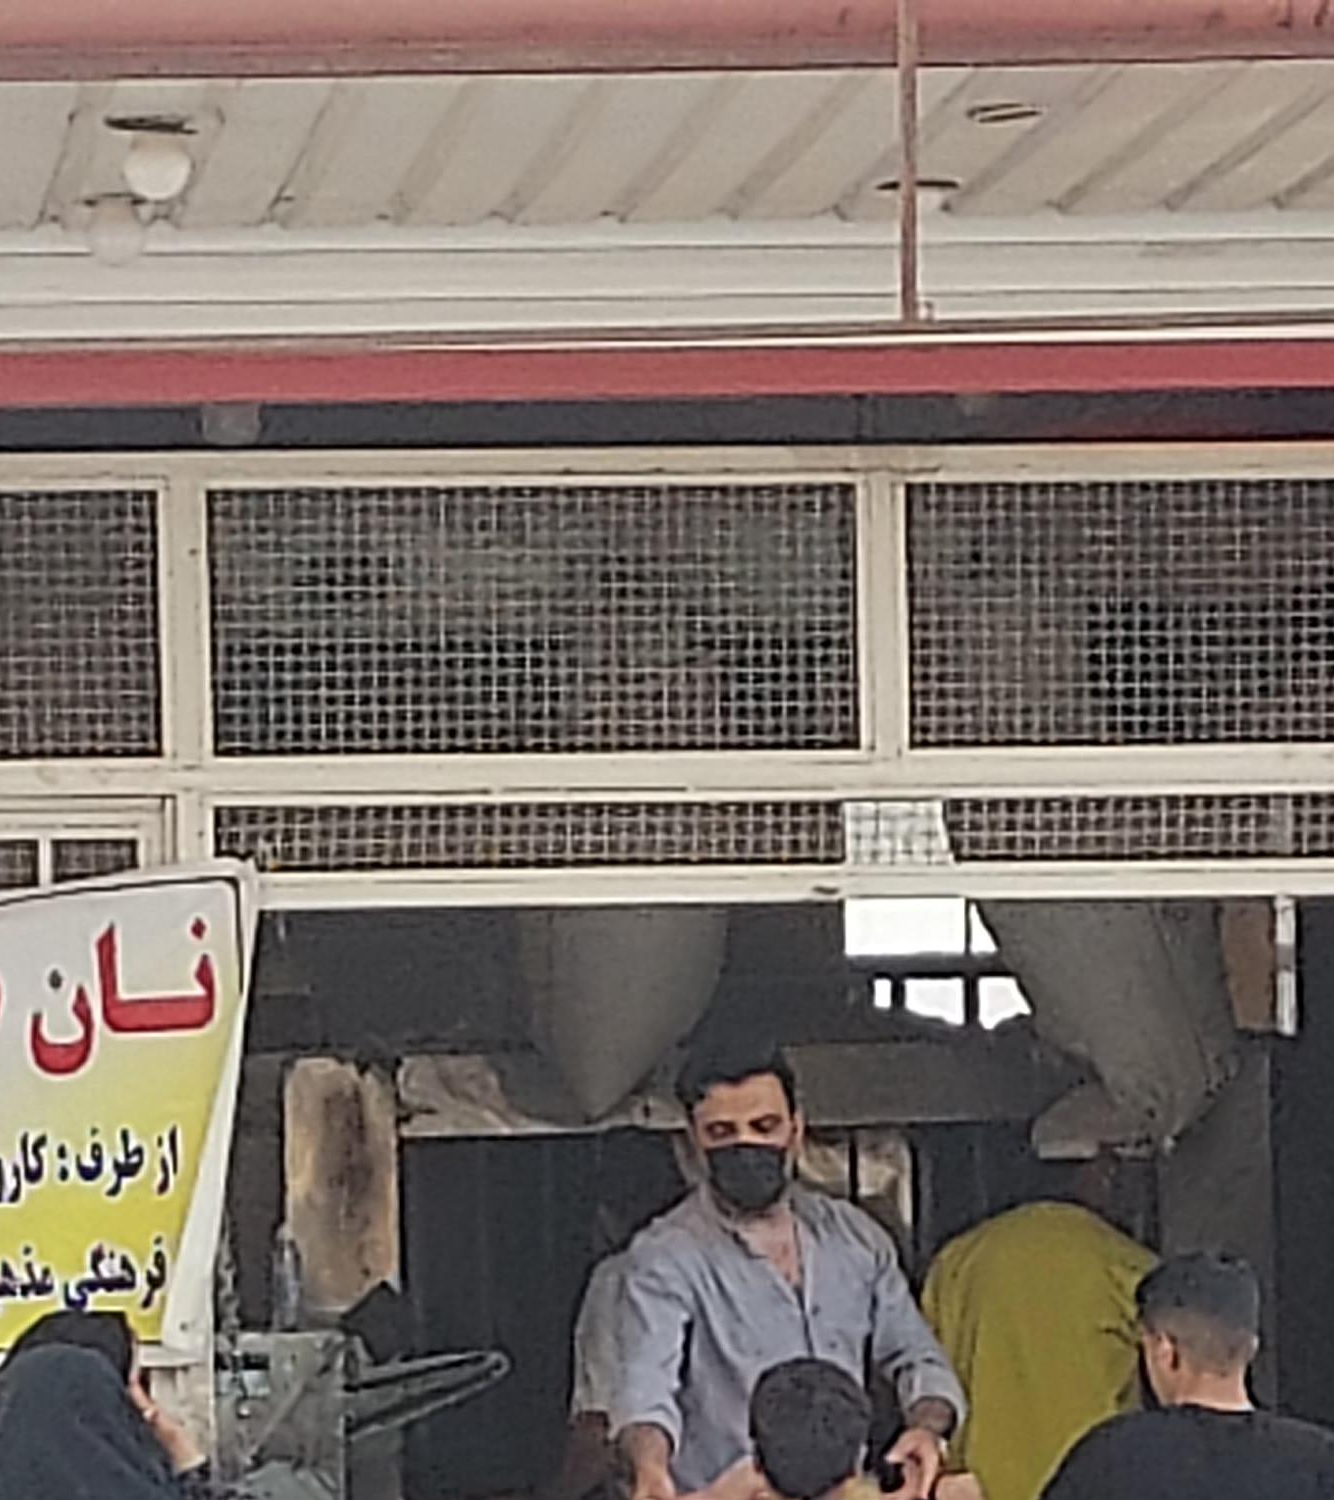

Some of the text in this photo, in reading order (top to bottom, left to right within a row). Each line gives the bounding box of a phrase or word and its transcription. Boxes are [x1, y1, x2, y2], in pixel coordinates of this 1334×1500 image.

[29, 916, 218, 1075] نان
[155, 1123, 179, 1196] از
[63, 1235, 168, 1310] فرهنگی
